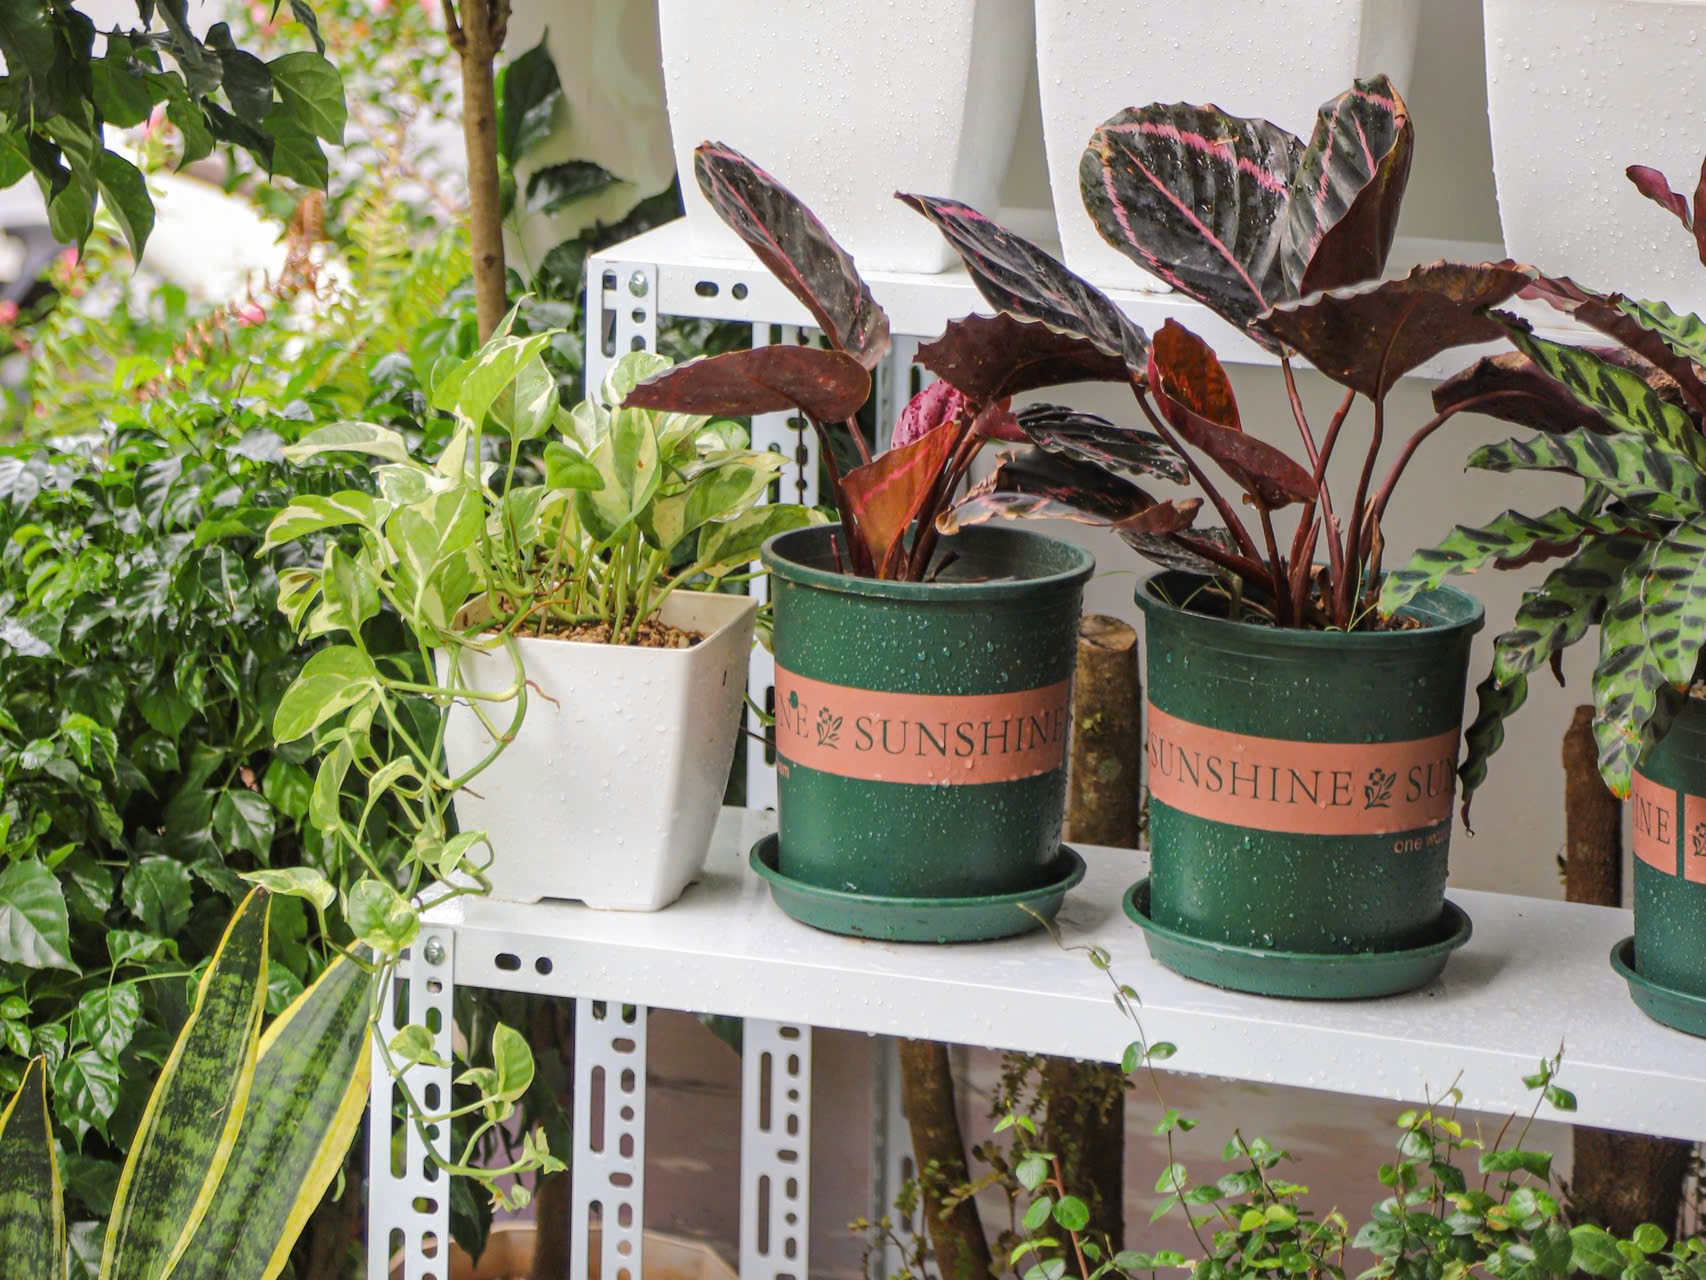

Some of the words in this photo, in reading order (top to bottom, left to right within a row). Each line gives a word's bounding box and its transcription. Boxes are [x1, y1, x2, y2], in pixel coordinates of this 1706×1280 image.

[1151, 731, 1352, 807] SUNSHINE
[1393, 837, 1422, 854] one
[1633, 790, 1670, 846] INE
